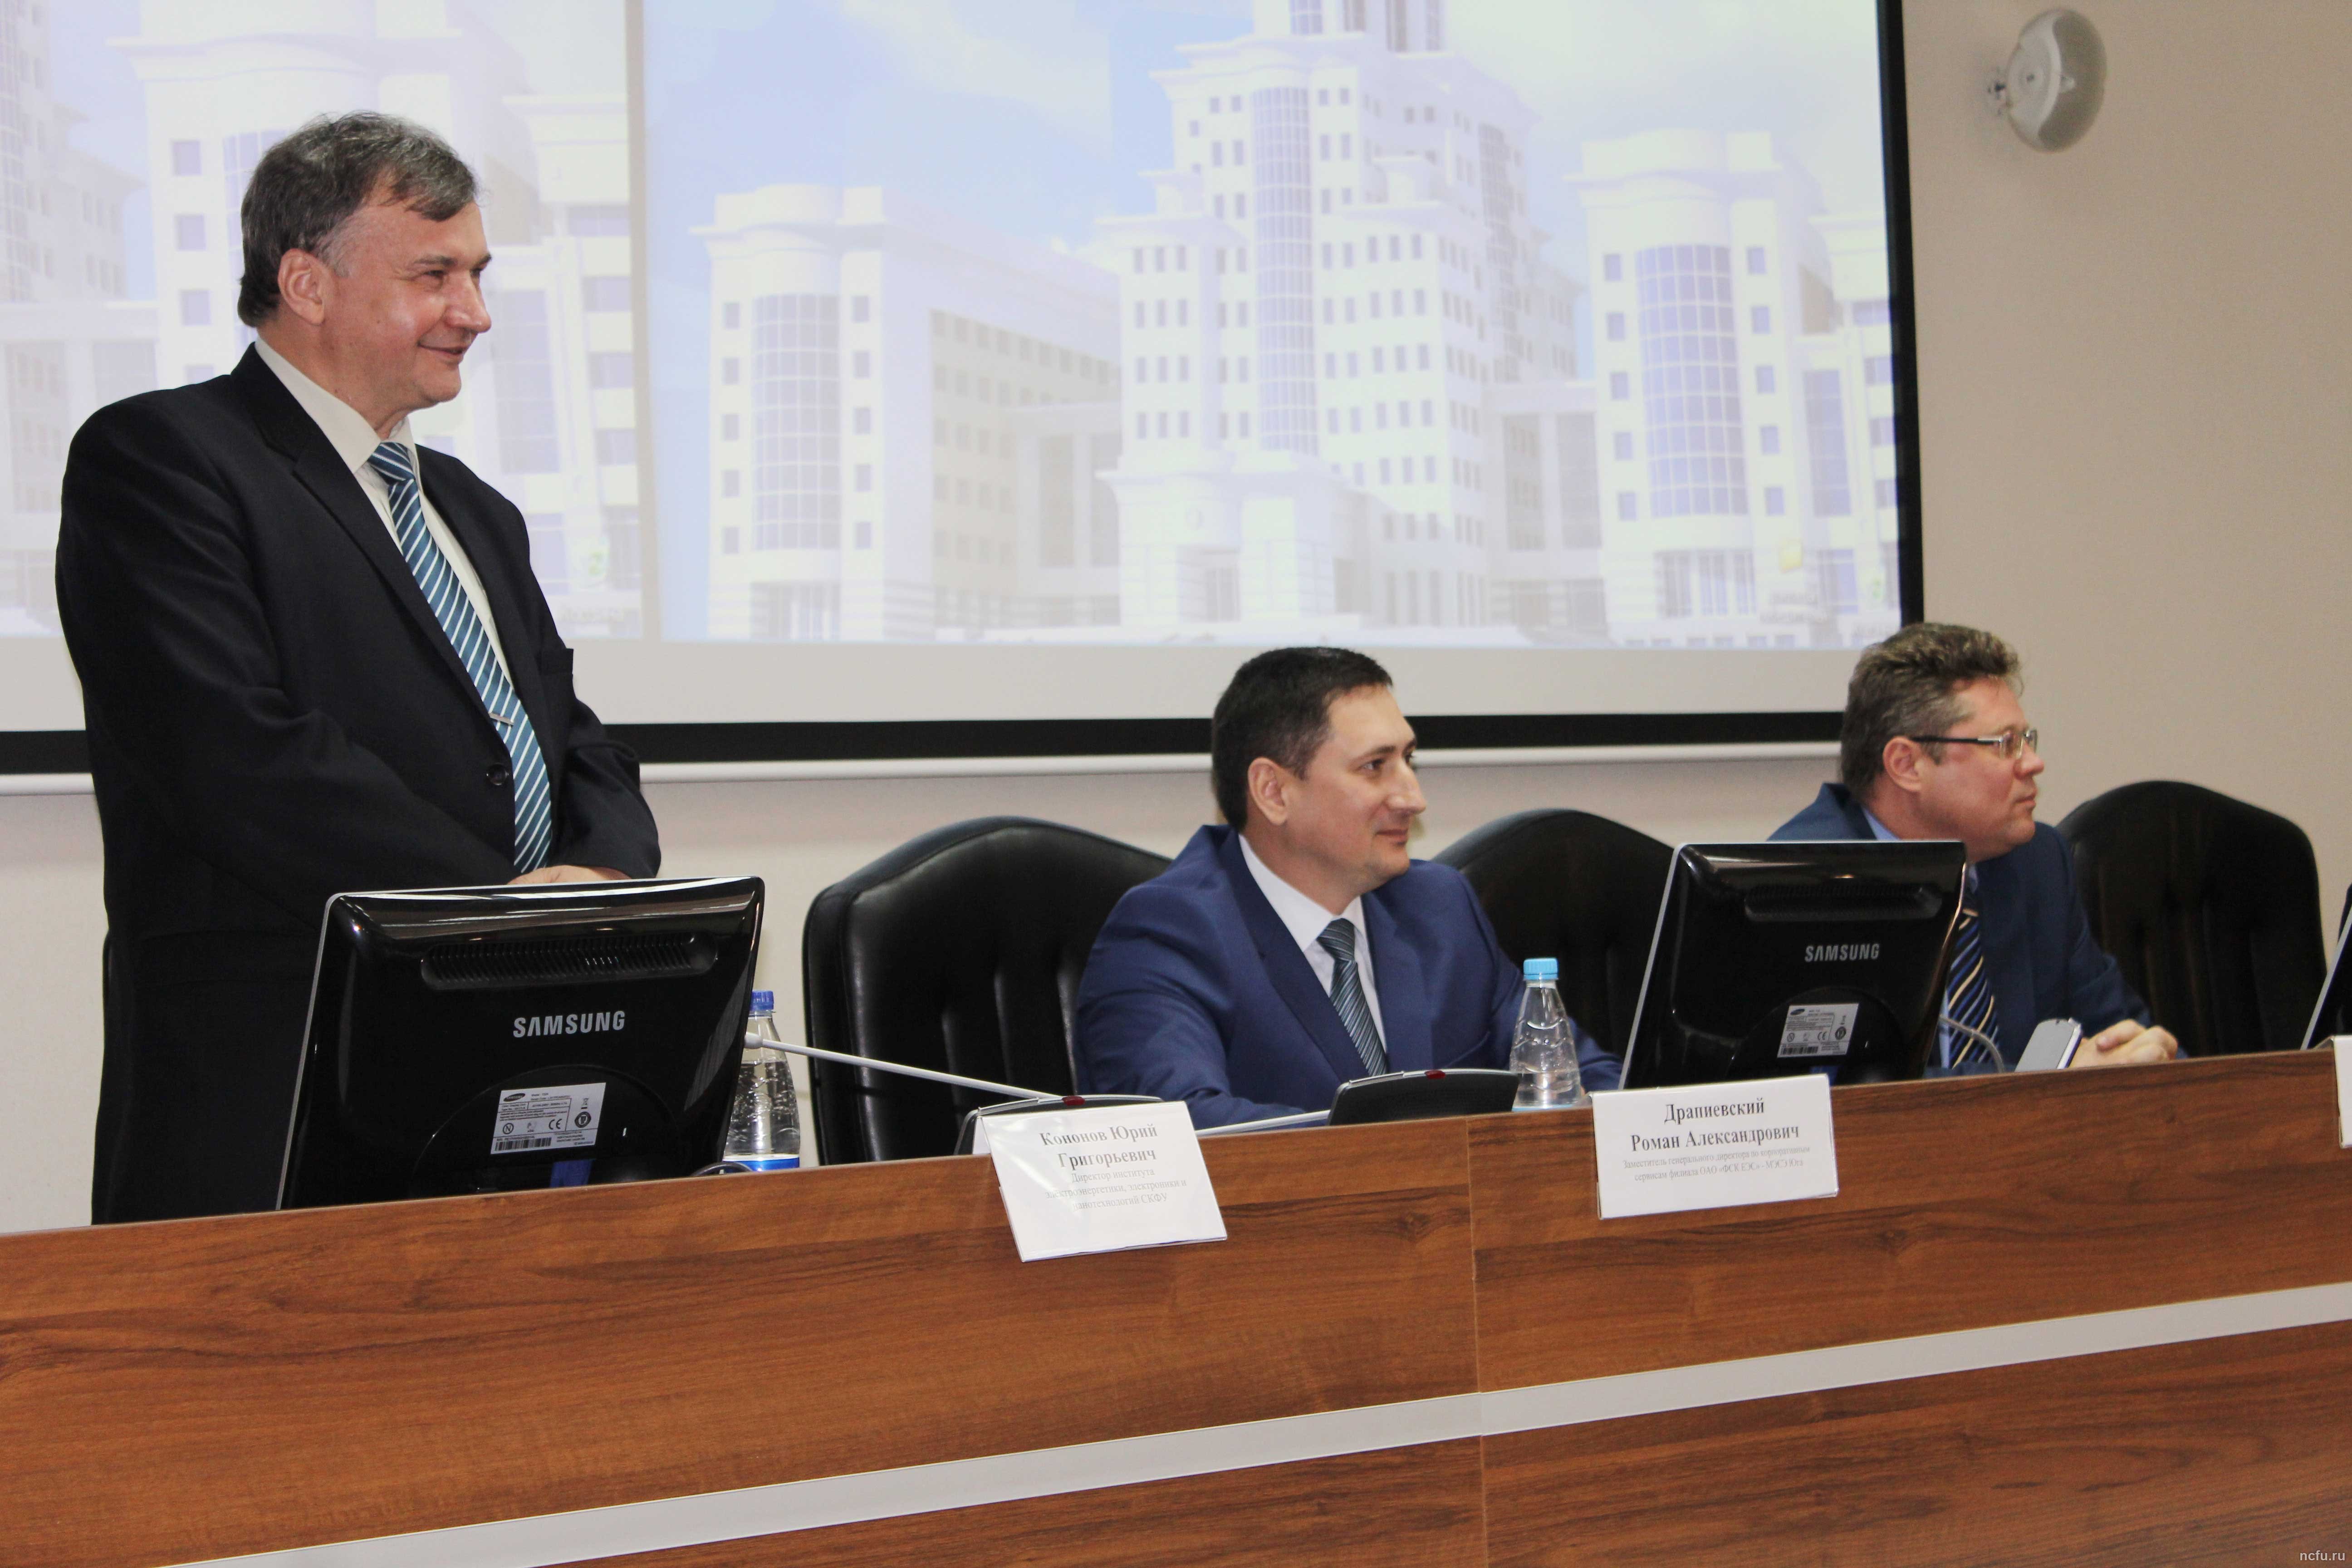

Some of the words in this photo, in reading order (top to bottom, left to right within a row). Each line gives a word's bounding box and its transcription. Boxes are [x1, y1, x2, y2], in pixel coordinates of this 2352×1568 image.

[1804, 943, 1880, 962] SAMSUNG
[513, 1010, 625, 1038] SAMSUNG
[1664, 1096, 1764, 1125] Драпиевский
[1039, 1131, 1107, 1146] Кононов
[1109, 1123, 1158, 1144] Юрий
[1630, 1134, 1680, 1152] Роман
[1685, 1126, 1800, 1147] Александрович
[1057, 1149, 1157, 1171] Григорьевич
[1623, 1159, 1667, 1169] Заместитель
[1668, 1155, 1714, 1166] генерального
[1071, 1171, 1111, 1183] Директор
[1113, 1168, 1155, 1180] института
[1634, 1172, 1667, 1183] сервисам
[1669, 1168, 1698, 1180] филиала
[1700, 1166, 1717, 1175] ОАО
[1045, 1185, 1127, 1199] электроэнергетики,
[1129, 1181, 1180, 1192] электроники
[1181, 1179, 1187, 1187] и
[1141, 1192, 1168, 1204] СКФУ
